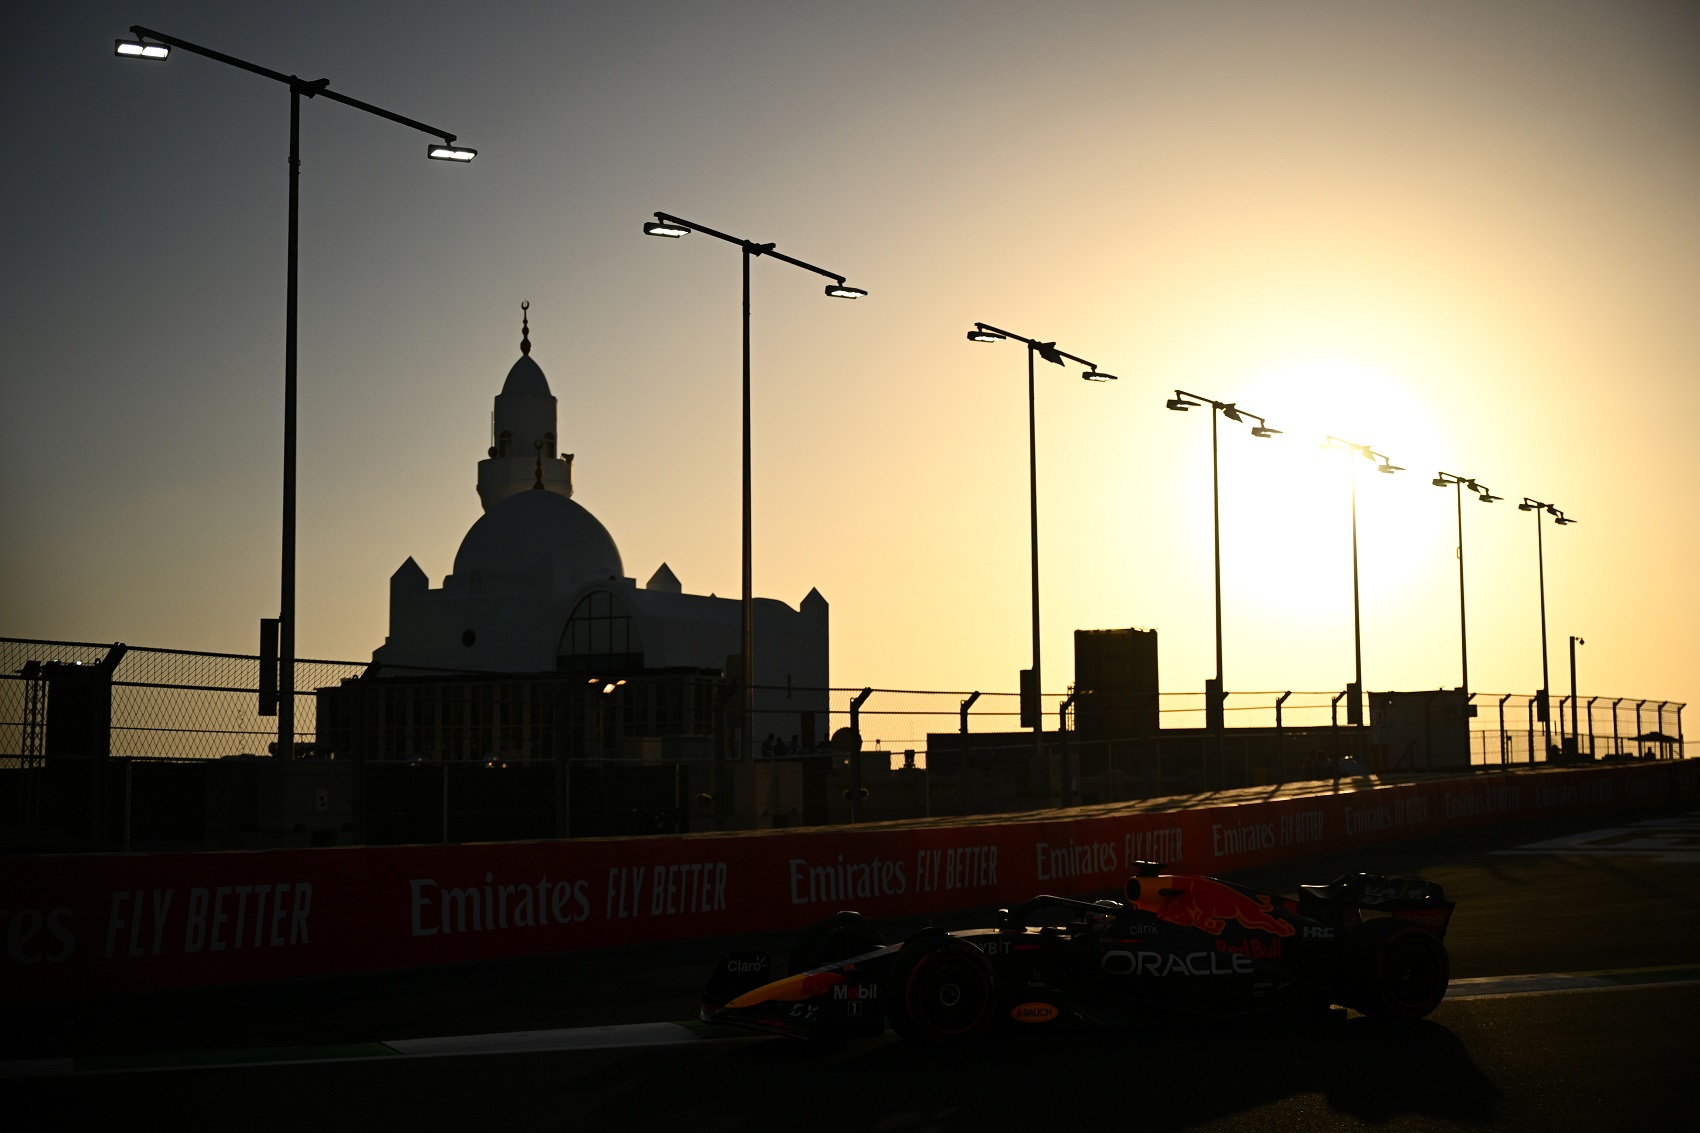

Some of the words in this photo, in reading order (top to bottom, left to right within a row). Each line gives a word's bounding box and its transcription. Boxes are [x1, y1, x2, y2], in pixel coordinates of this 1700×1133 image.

[1344, 803, 1392, 835] Emirates
[1406, 796, 1428, 824] BETTER
[1446, 793, 1484, 819] Emirates
[1212, 820, 1275, 857] Emirates
[1280, 814, 1295, 847] FLY
[1296, 811, 1323, 844] BETTER
[1036, 838, 1117, 880] Emirates
[1125, 832, 1143, 869] FLY
[1146, 828, 1183, 863] BETTER
[789, 853, 906, 905] Emirates
[916, 849, 942, 893] FLY
[946, 845, 998, 890] BETTER
[409, 872, 591, 936] Emirates
[606, 866, 645, 920] FLY
[651, 862, 728, 917] BETTER
[104, 888, 174, 960] FLY
[184, 882, 313, 955] BETTER
[1129, 923, 1159, 936] citrix
[1302, 926, 1335, 939] HRC
[1250, 938, 1281, 960] Bull
[727, 959, 763, 973] Claro
[1100, 950, 1255, 976] ORACLE
[833, 984, 878, 1001] Mobil
[1022, 1008, 1053, 1018] RAUCH
